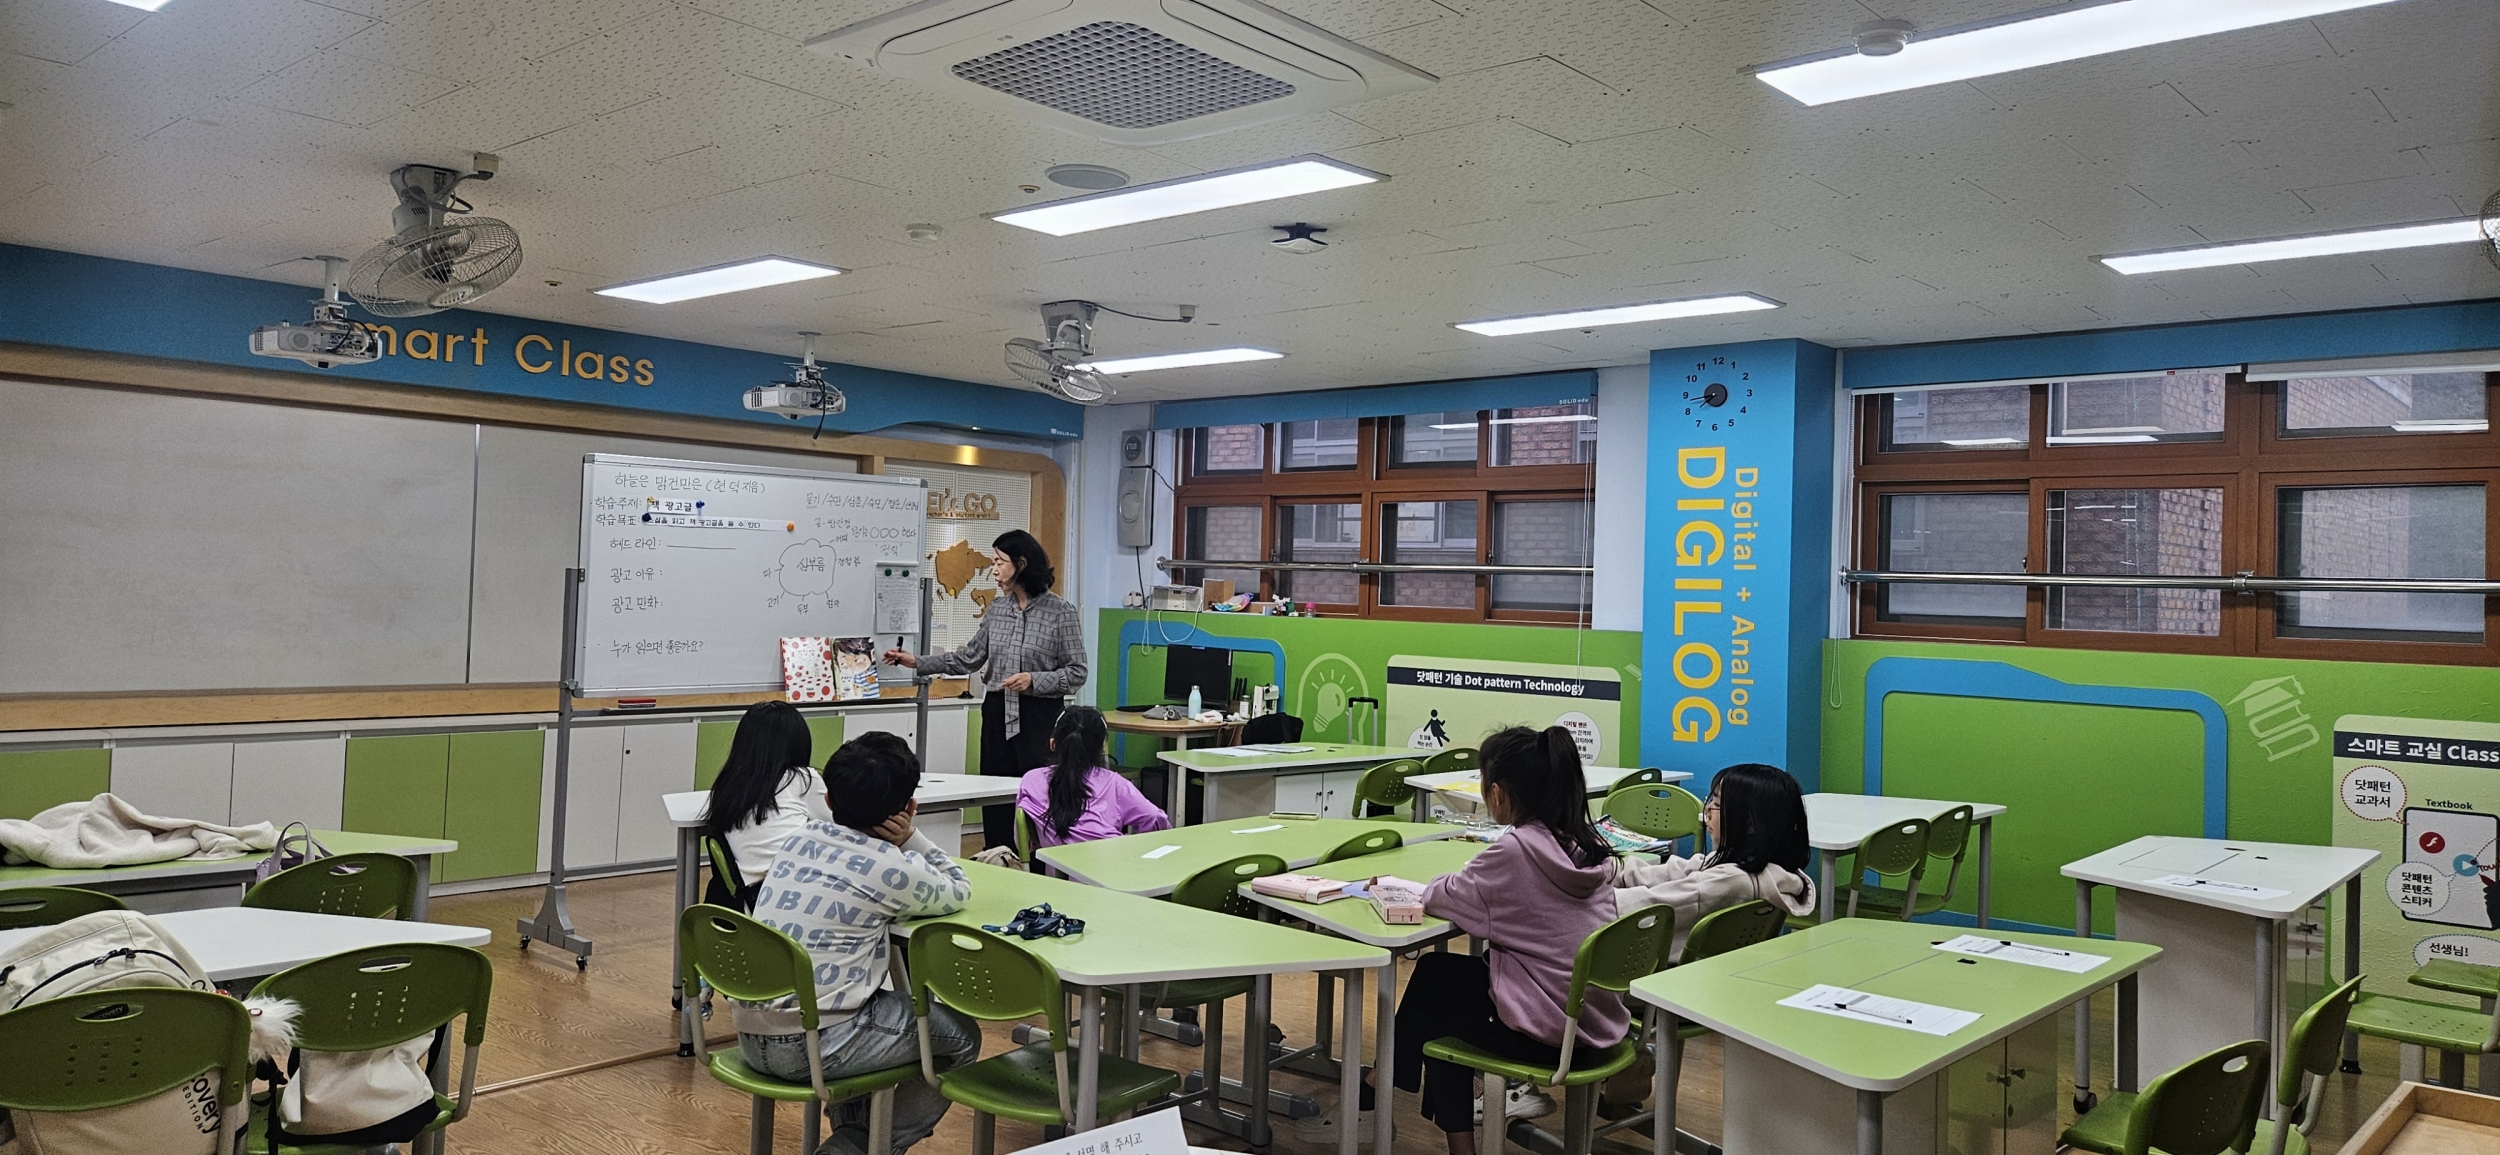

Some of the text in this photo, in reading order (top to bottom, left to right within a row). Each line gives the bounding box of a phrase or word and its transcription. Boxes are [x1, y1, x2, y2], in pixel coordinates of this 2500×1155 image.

[355, 322, 655, 386] mart Class
[1713, 357, 1725, 365] 12
[1696, 363, 1706, 371] 11
[1731, 361, 1736, 369] 1
[1742, 372, 1749, 380] 2
[1683, 391, 1689, 399] 9
[1746, 389, 1753, 397] 3
[1740, 406, 1747, 414] 4
[1712, 423, 1718, 431] 6
[1728, 419, 1734, 427] 5
[614, 471, 649, 488] 하늘은
[665, 501, 692, 512] 광고글
[964, 492, 997, 512] GO
[796, 556, 825, 572] 심부름
[610, 567, 632, 583] 광고
[1672, 446, 1726, 743] DIGILOG
[1728, 467, 1759, 726] Digital + Analog
[612, 595, 633, 614] 광고
[611, 639, 632, 658] 누가
[1416, 671, 1585, 696] 닷패턴 기술 Dot pattern Technology
[2347, 737, 2500, 762] 스마트 교실 Class
[2354, 779, 2391, 793] 닷패턴
[2354, 794, 2391, 808] 교과서
[2425, 798, 2473, 810] Textbook
[2401, 872, 2433, 884] 닷패턴
[2401, 884, 2433, 895] 콘텐츠
[2401, 895, 2432, 907] 스티커
[2430, 942, 2469, 957] 선생님!
[182, 1086, 204, 1130] EDITION
[191, 1074, 222, 1134] overy
[1100, 1141, 1110, 1154] 해
[1115, 1132, 1143, 1151] 주시고
